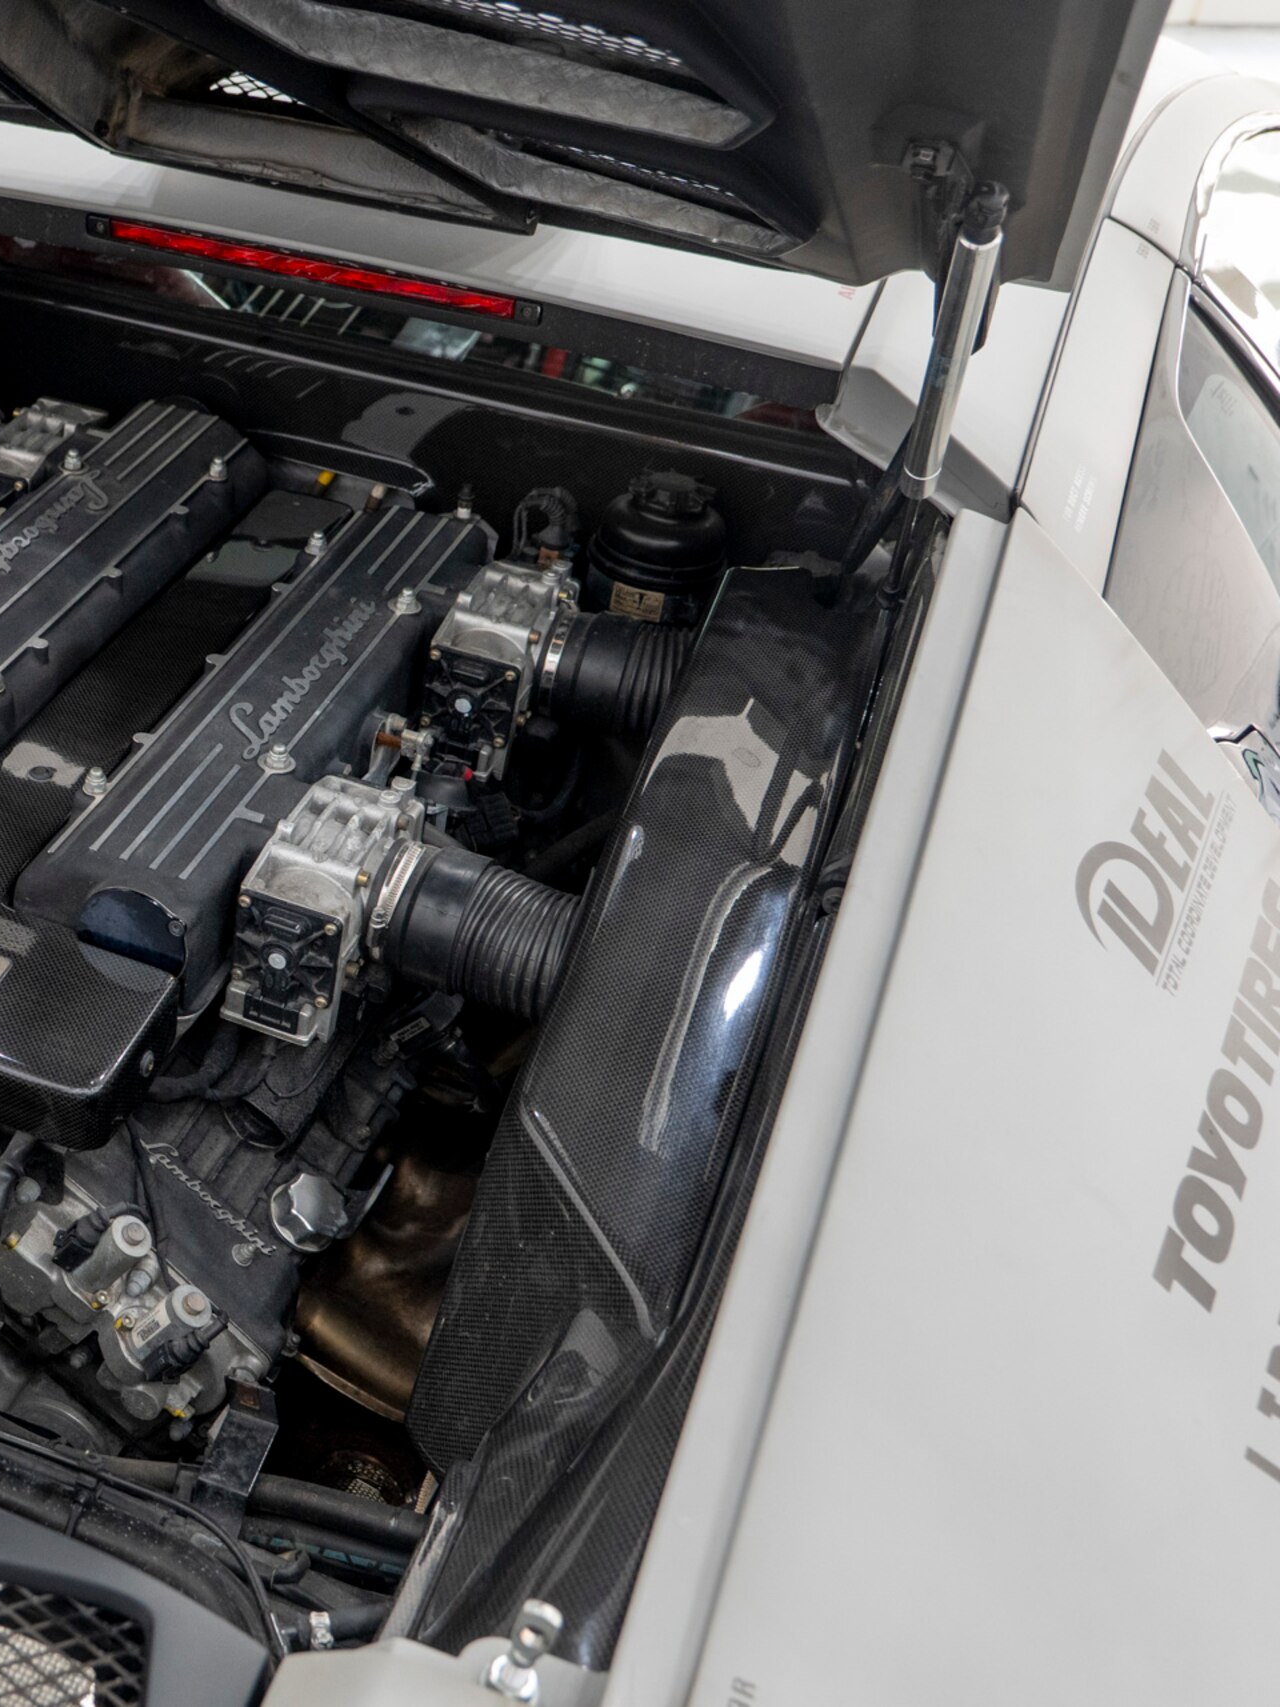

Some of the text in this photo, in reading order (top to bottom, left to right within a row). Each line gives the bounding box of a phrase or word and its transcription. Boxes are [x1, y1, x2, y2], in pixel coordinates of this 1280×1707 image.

[229, 597, 377, 761] Lamborghini
[1074, 748, 1216, 977] IDEAL
[1160, 792, 1238, 998] TOTAL COORDINATE DEVELOPMENT
[140, 1138, 277, 1256] Lamborghini
[1151, 877, 1280, 1314] TOYOTIR
